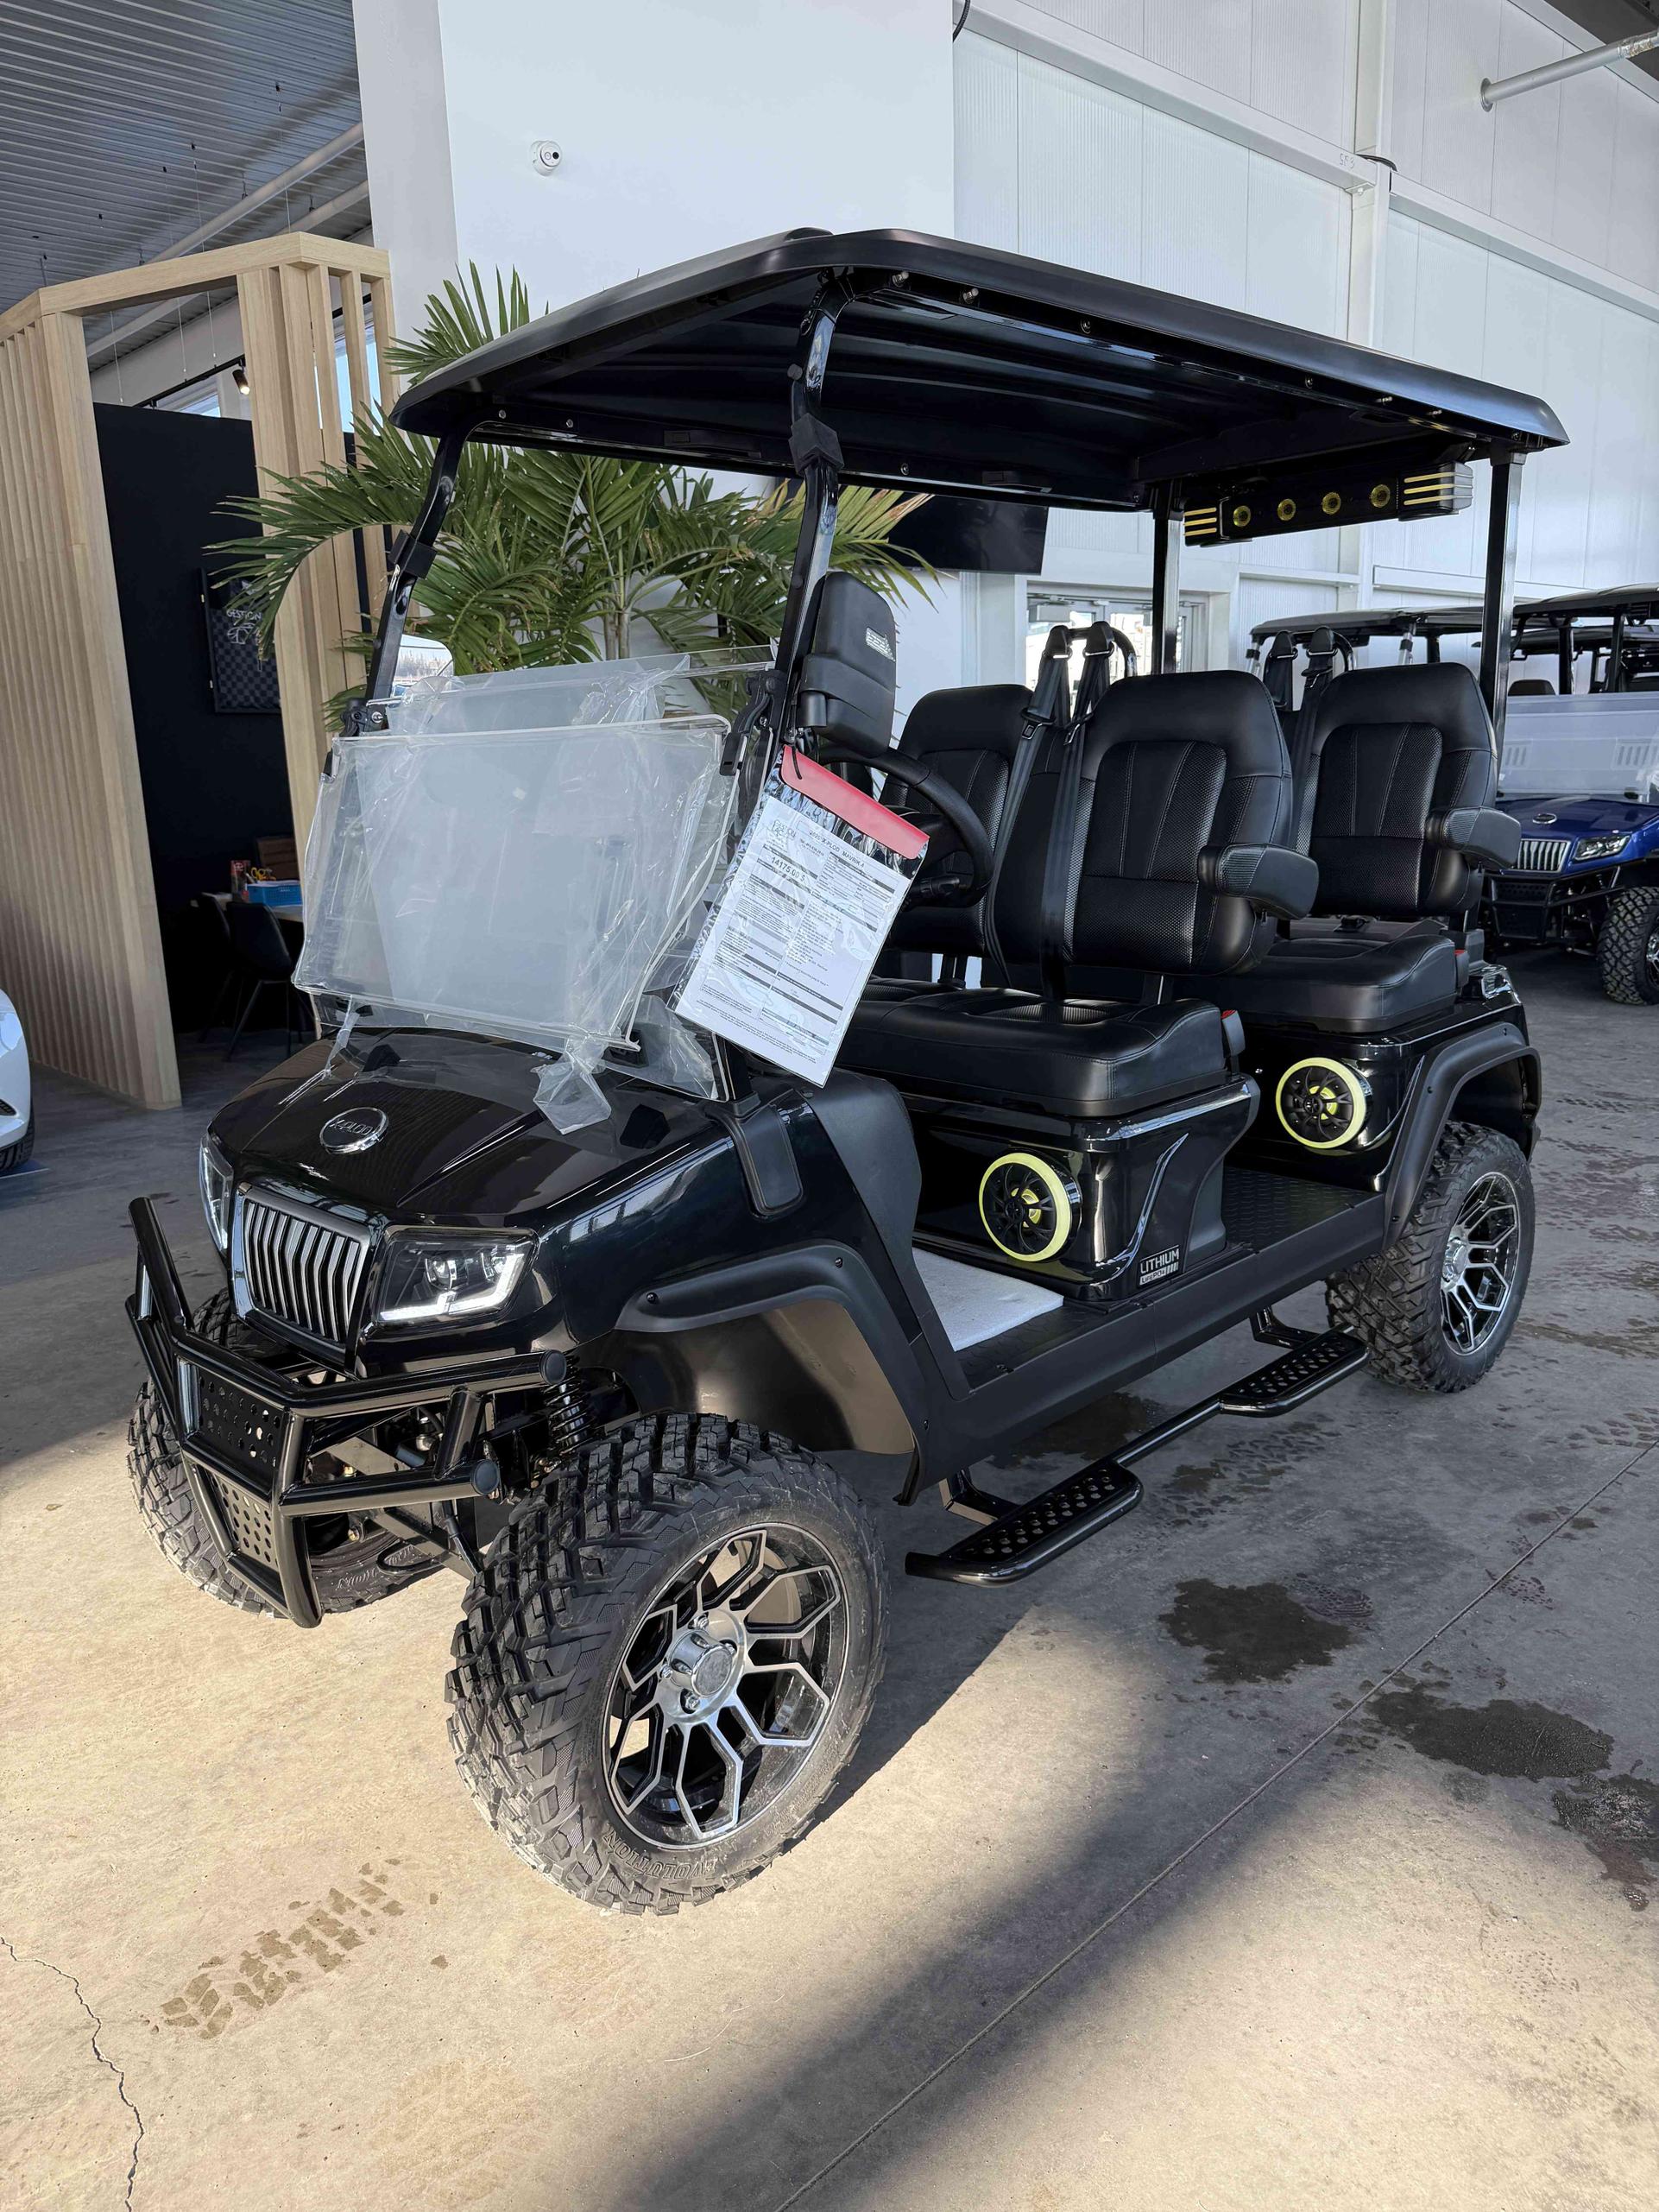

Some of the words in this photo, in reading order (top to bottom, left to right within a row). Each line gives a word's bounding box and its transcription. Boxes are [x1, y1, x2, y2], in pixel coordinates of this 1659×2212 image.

[771, 856, 800, 879] 14175.00
[842, 850, 861, 865] MAVRIK
[1140, 1248, 1180, 1274] LITHIUM
[603, 1829, 717, 1878] EVOLUTION
